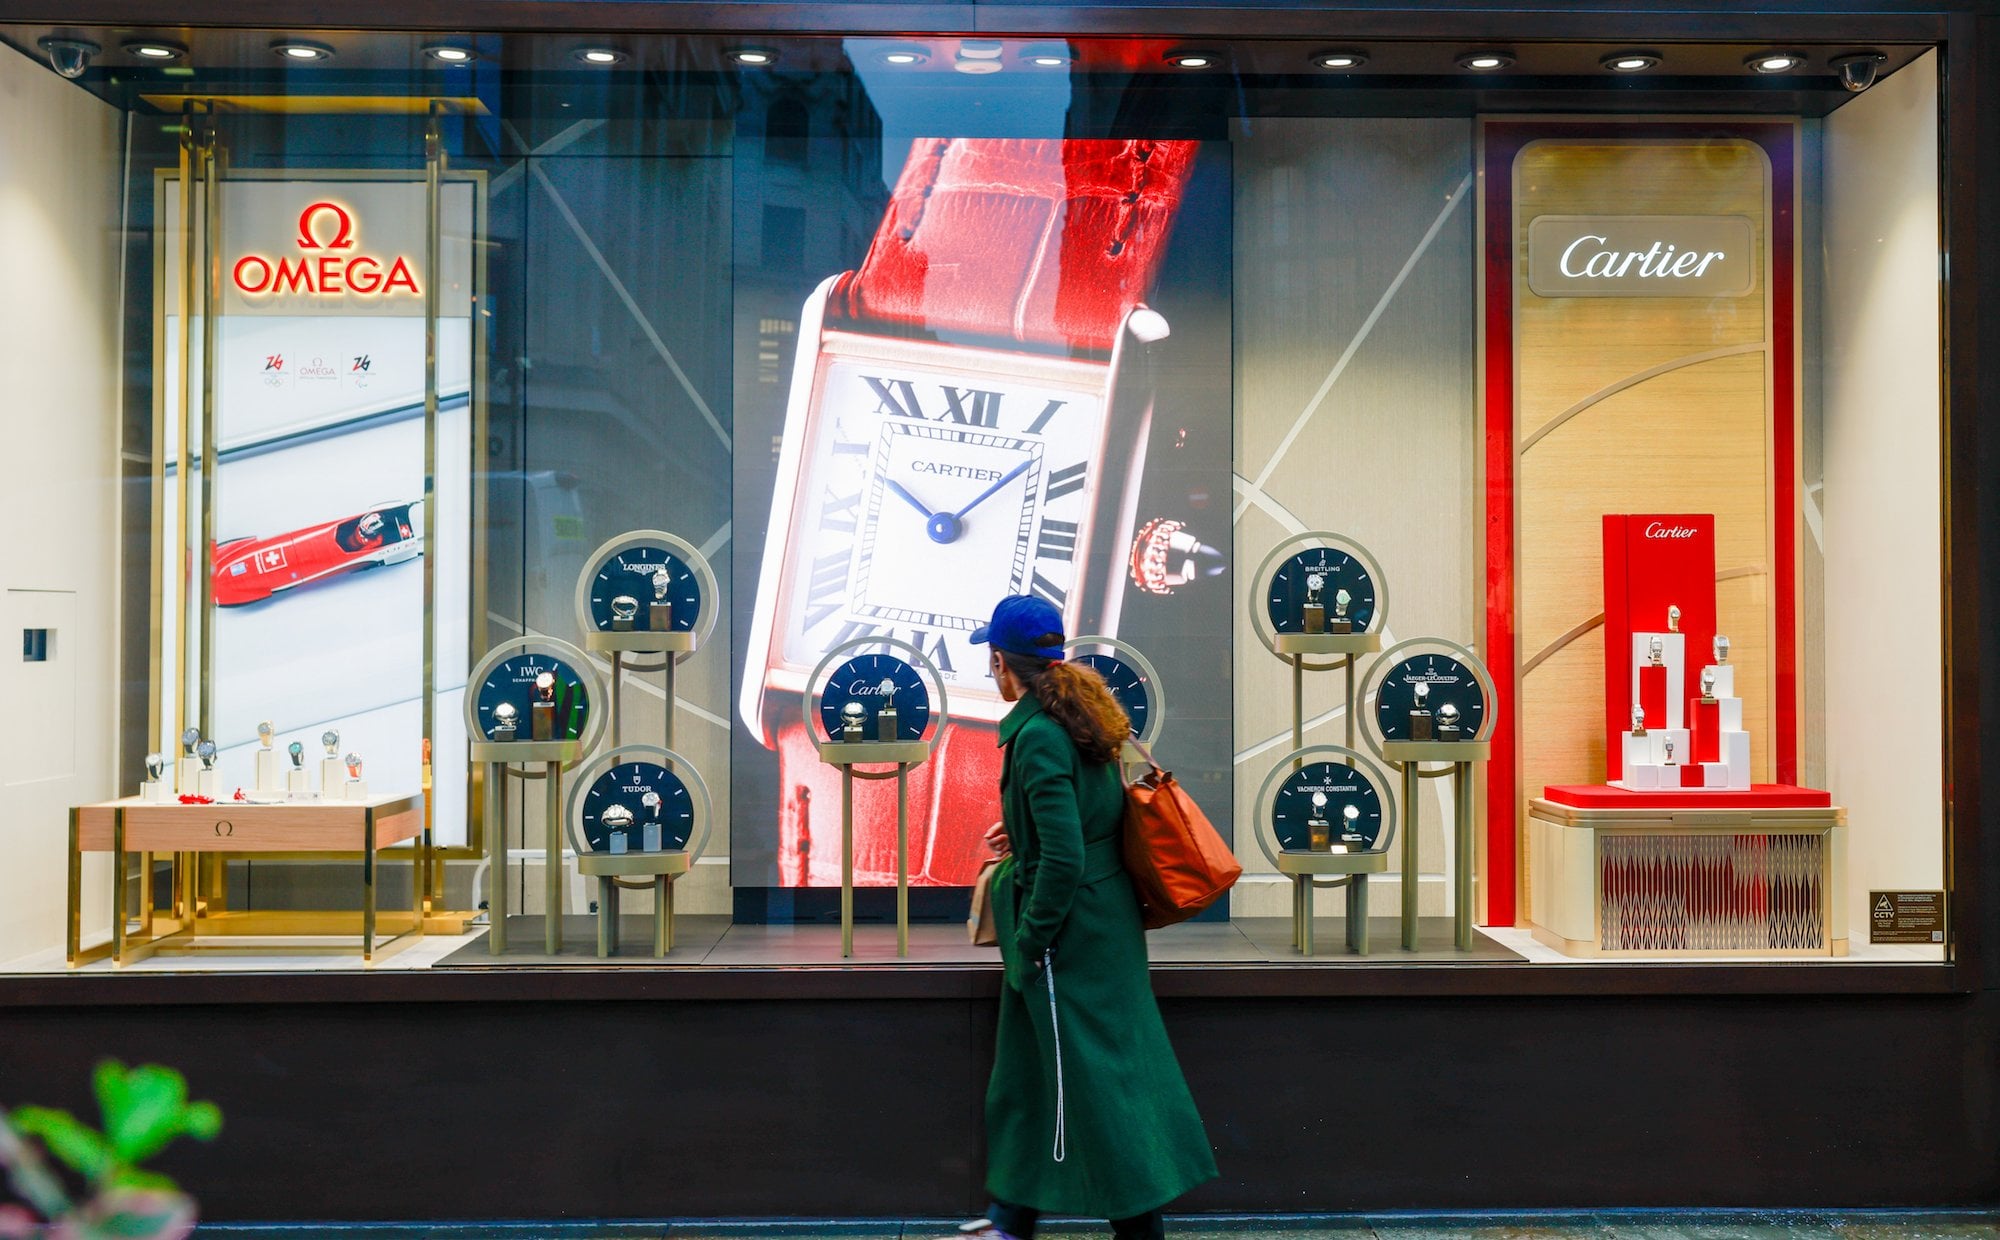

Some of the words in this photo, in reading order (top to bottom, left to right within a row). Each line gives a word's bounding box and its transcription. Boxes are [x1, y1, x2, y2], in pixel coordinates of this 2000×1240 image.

[1559, 235, 1725, 278] Cartier
[233, 256, 419, 293] OMEGA
[299, 368, 336, 376] OMEGA
[859, 375, 928, 419] XI
[933, 385, 1005, 429] XII
[911, 460, 1003, 482] CARTIER
[1645, 521, 1698, 538] Cartier
[520, 666, 544, 677] IWC
[1873, 911, 1895, 919] CCTV
